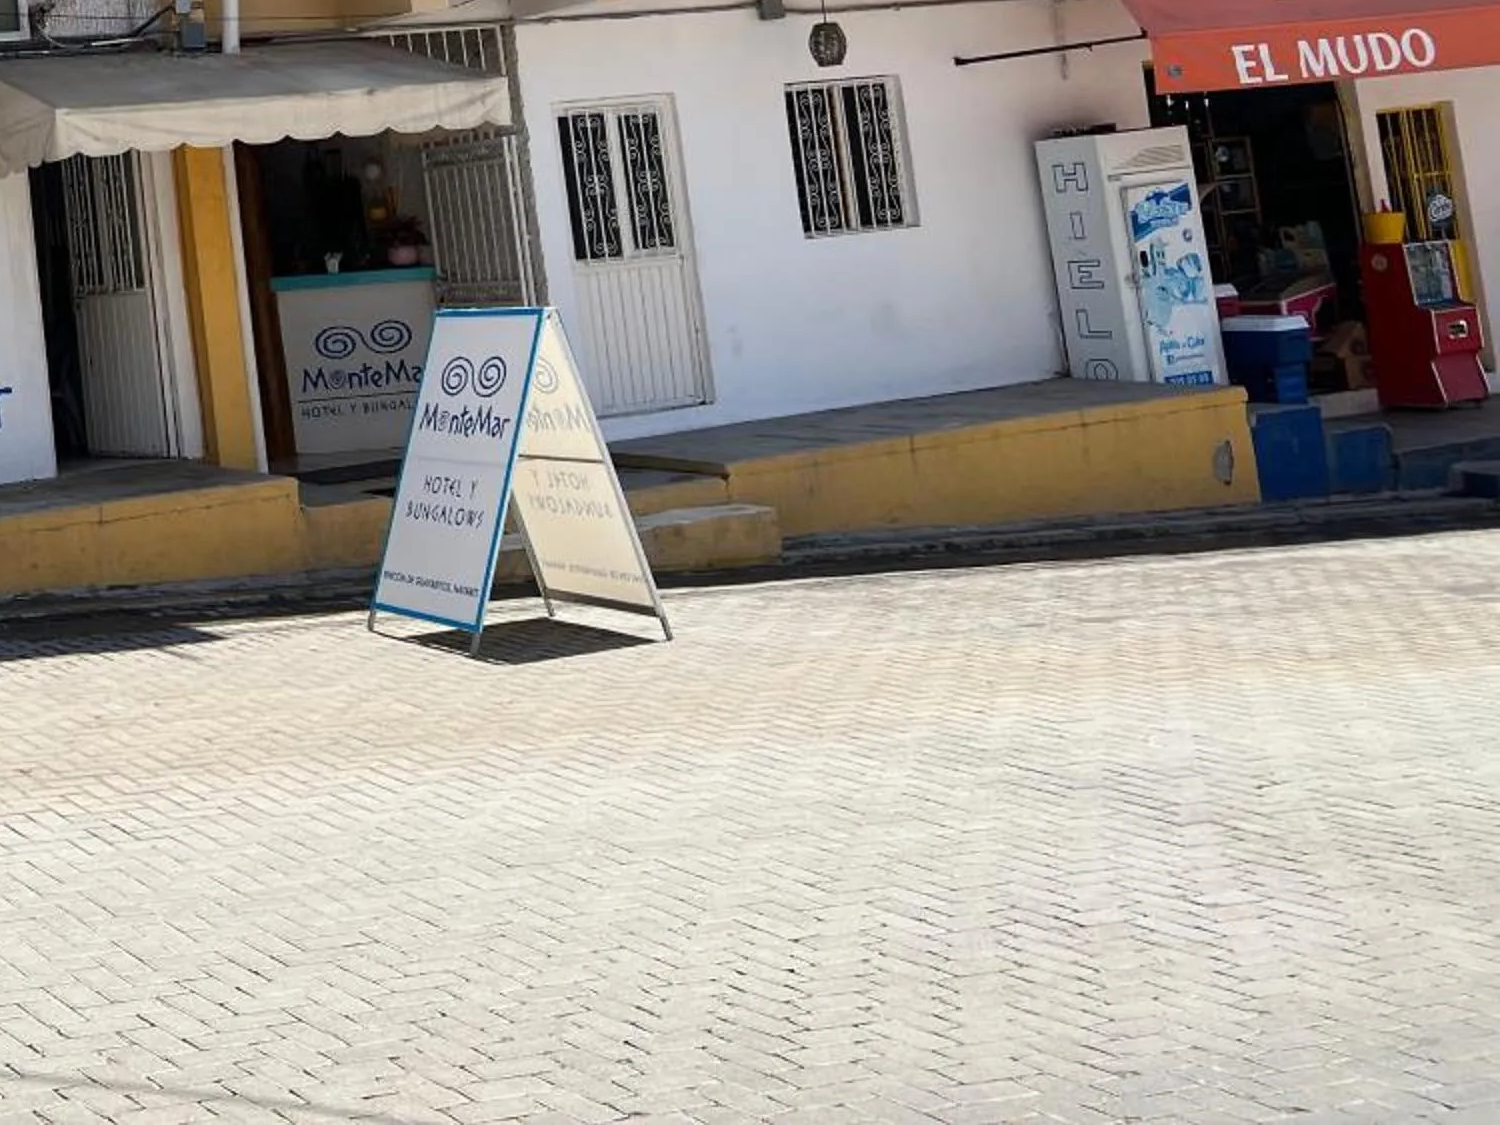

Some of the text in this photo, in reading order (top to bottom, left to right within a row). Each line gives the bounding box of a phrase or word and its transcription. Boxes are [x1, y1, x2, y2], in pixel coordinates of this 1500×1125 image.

[1231, 28, 1436, 85] EL MUDO
[302, 359, 423, 393] MonteMa
[419, 403, 511, 440] MonteMar
[423, 476, 479, 498] HOTEL Y
[405, 500, 485, 529] BUNGALOWS
